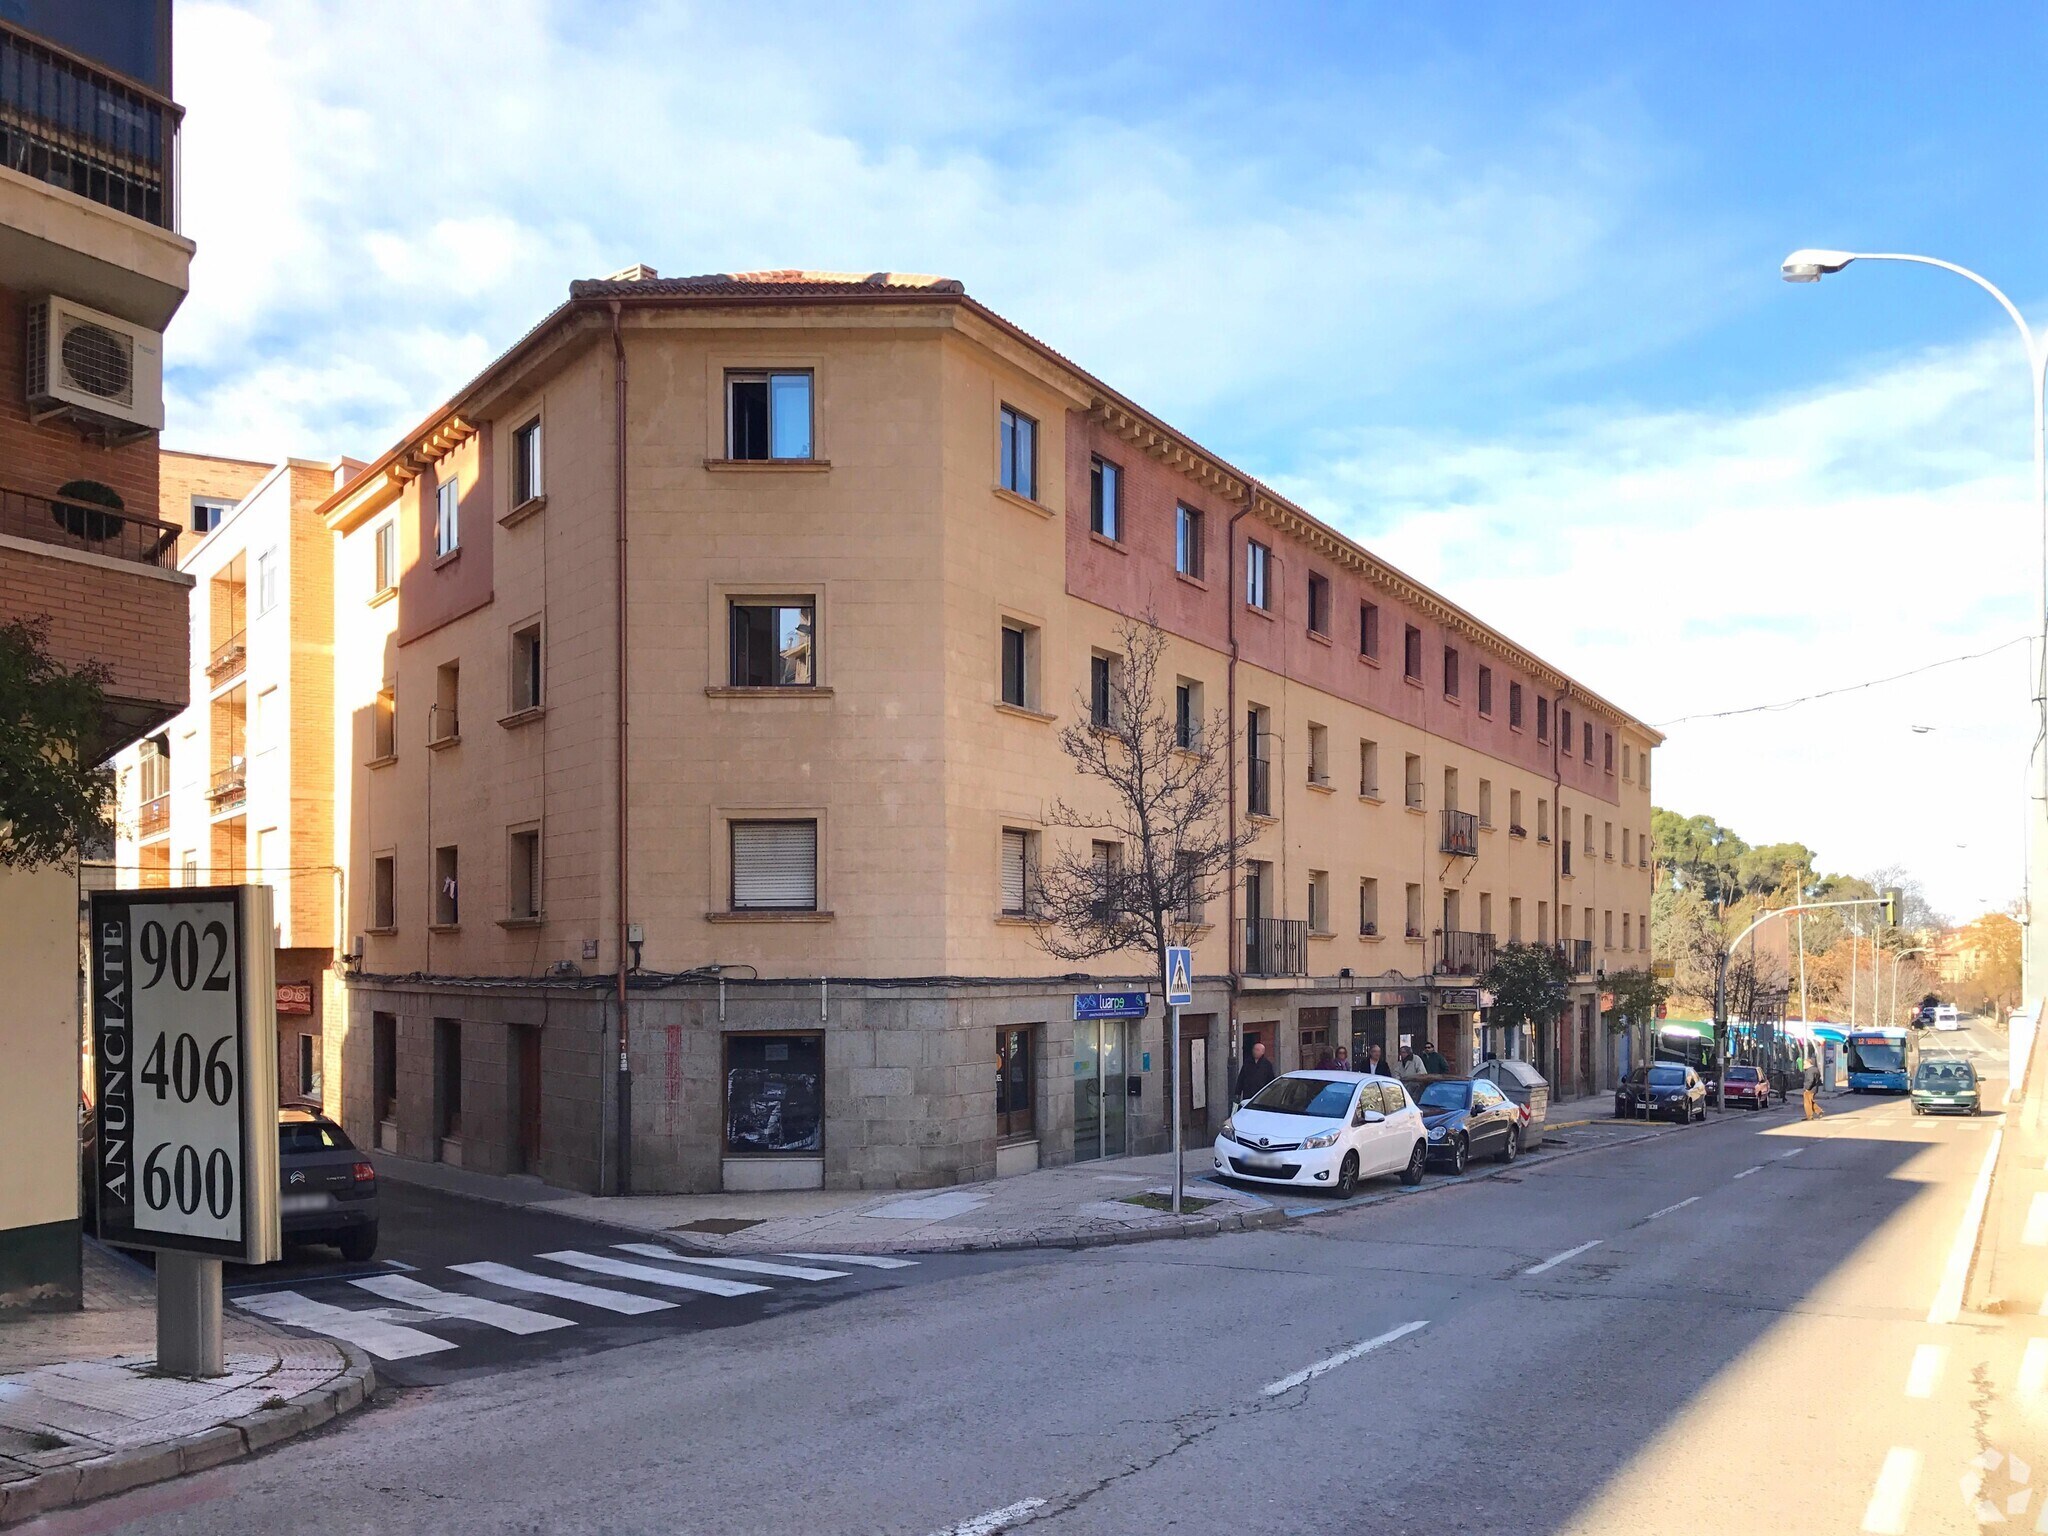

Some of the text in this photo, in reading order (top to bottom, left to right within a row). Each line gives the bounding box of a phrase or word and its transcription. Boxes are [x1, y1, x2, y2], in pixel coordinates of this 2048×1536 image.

[140, 920, 231, 992] 902
[103, 920, 127, 1204] ANUNCIATE
[140, 1031, 233, 1106] 406
[143, 1142, 233, 1220] 600
